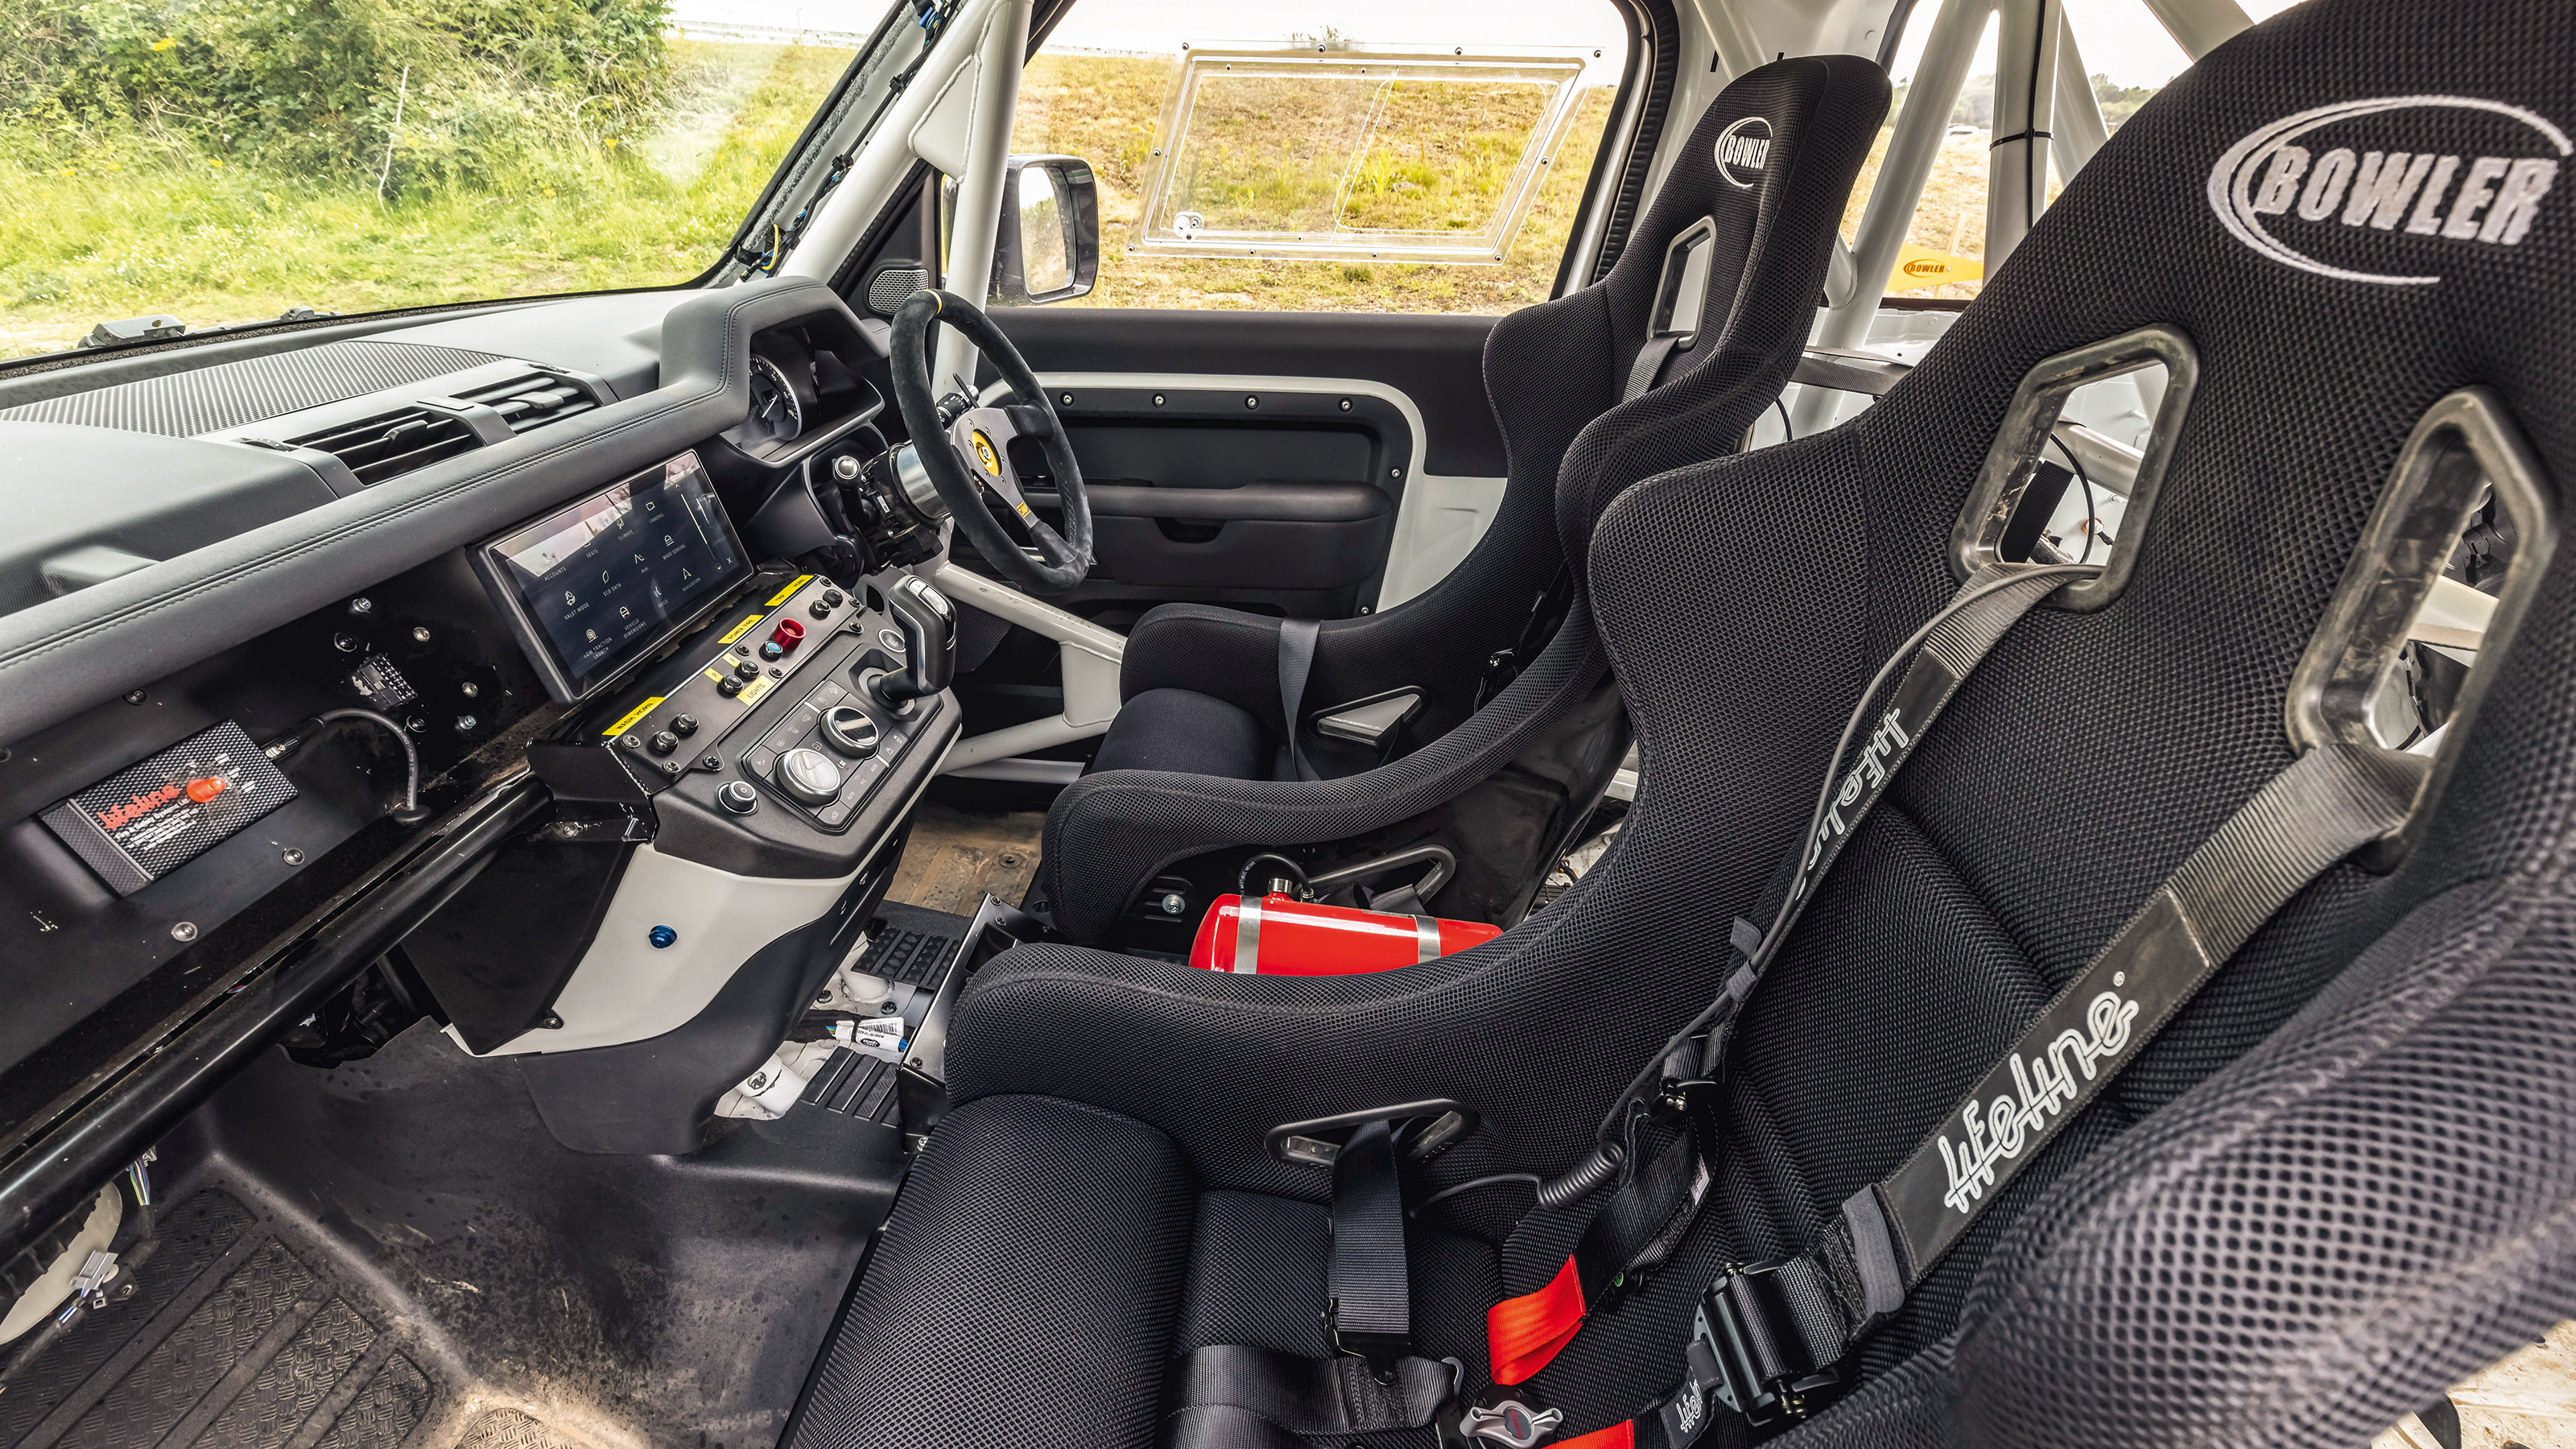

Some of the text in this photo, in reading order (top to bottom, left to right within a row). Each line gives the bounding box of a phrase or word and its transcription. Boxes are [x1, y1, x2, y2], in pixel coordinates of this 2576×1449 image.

[1724, 135, 1770, 170] BOWLER
[2255, 144, 2559, 246] BOWLER
[1909, 264, 1945, 273] BOWLER
[649, 513, 665, 524] CAMERAS
[617, 529, 634, 541] CLIMATE
[585, 549, 598, 559] SEATS
[672, 543, 686, 555] SENSING
[544, 566, 567, 581] ACCOUNTS
[611, 583, 622, 592] DATA
[682, 577, 701, 592] NAVIGATION
[564, 602, 590, 620] VALET MODE
[623, 621, 646, 639] DIMENSIONS
[625, 618, 640, 630] VEHICLE
[583, 637, 612, 658] LOW TRACTION
[593, 646, 609, 660] LAUNCH
[747, 683, 766, 699] LIGHTS
[616, 703, 654, 730] WASH HORN
[114, 828, 130, 840] Fire
